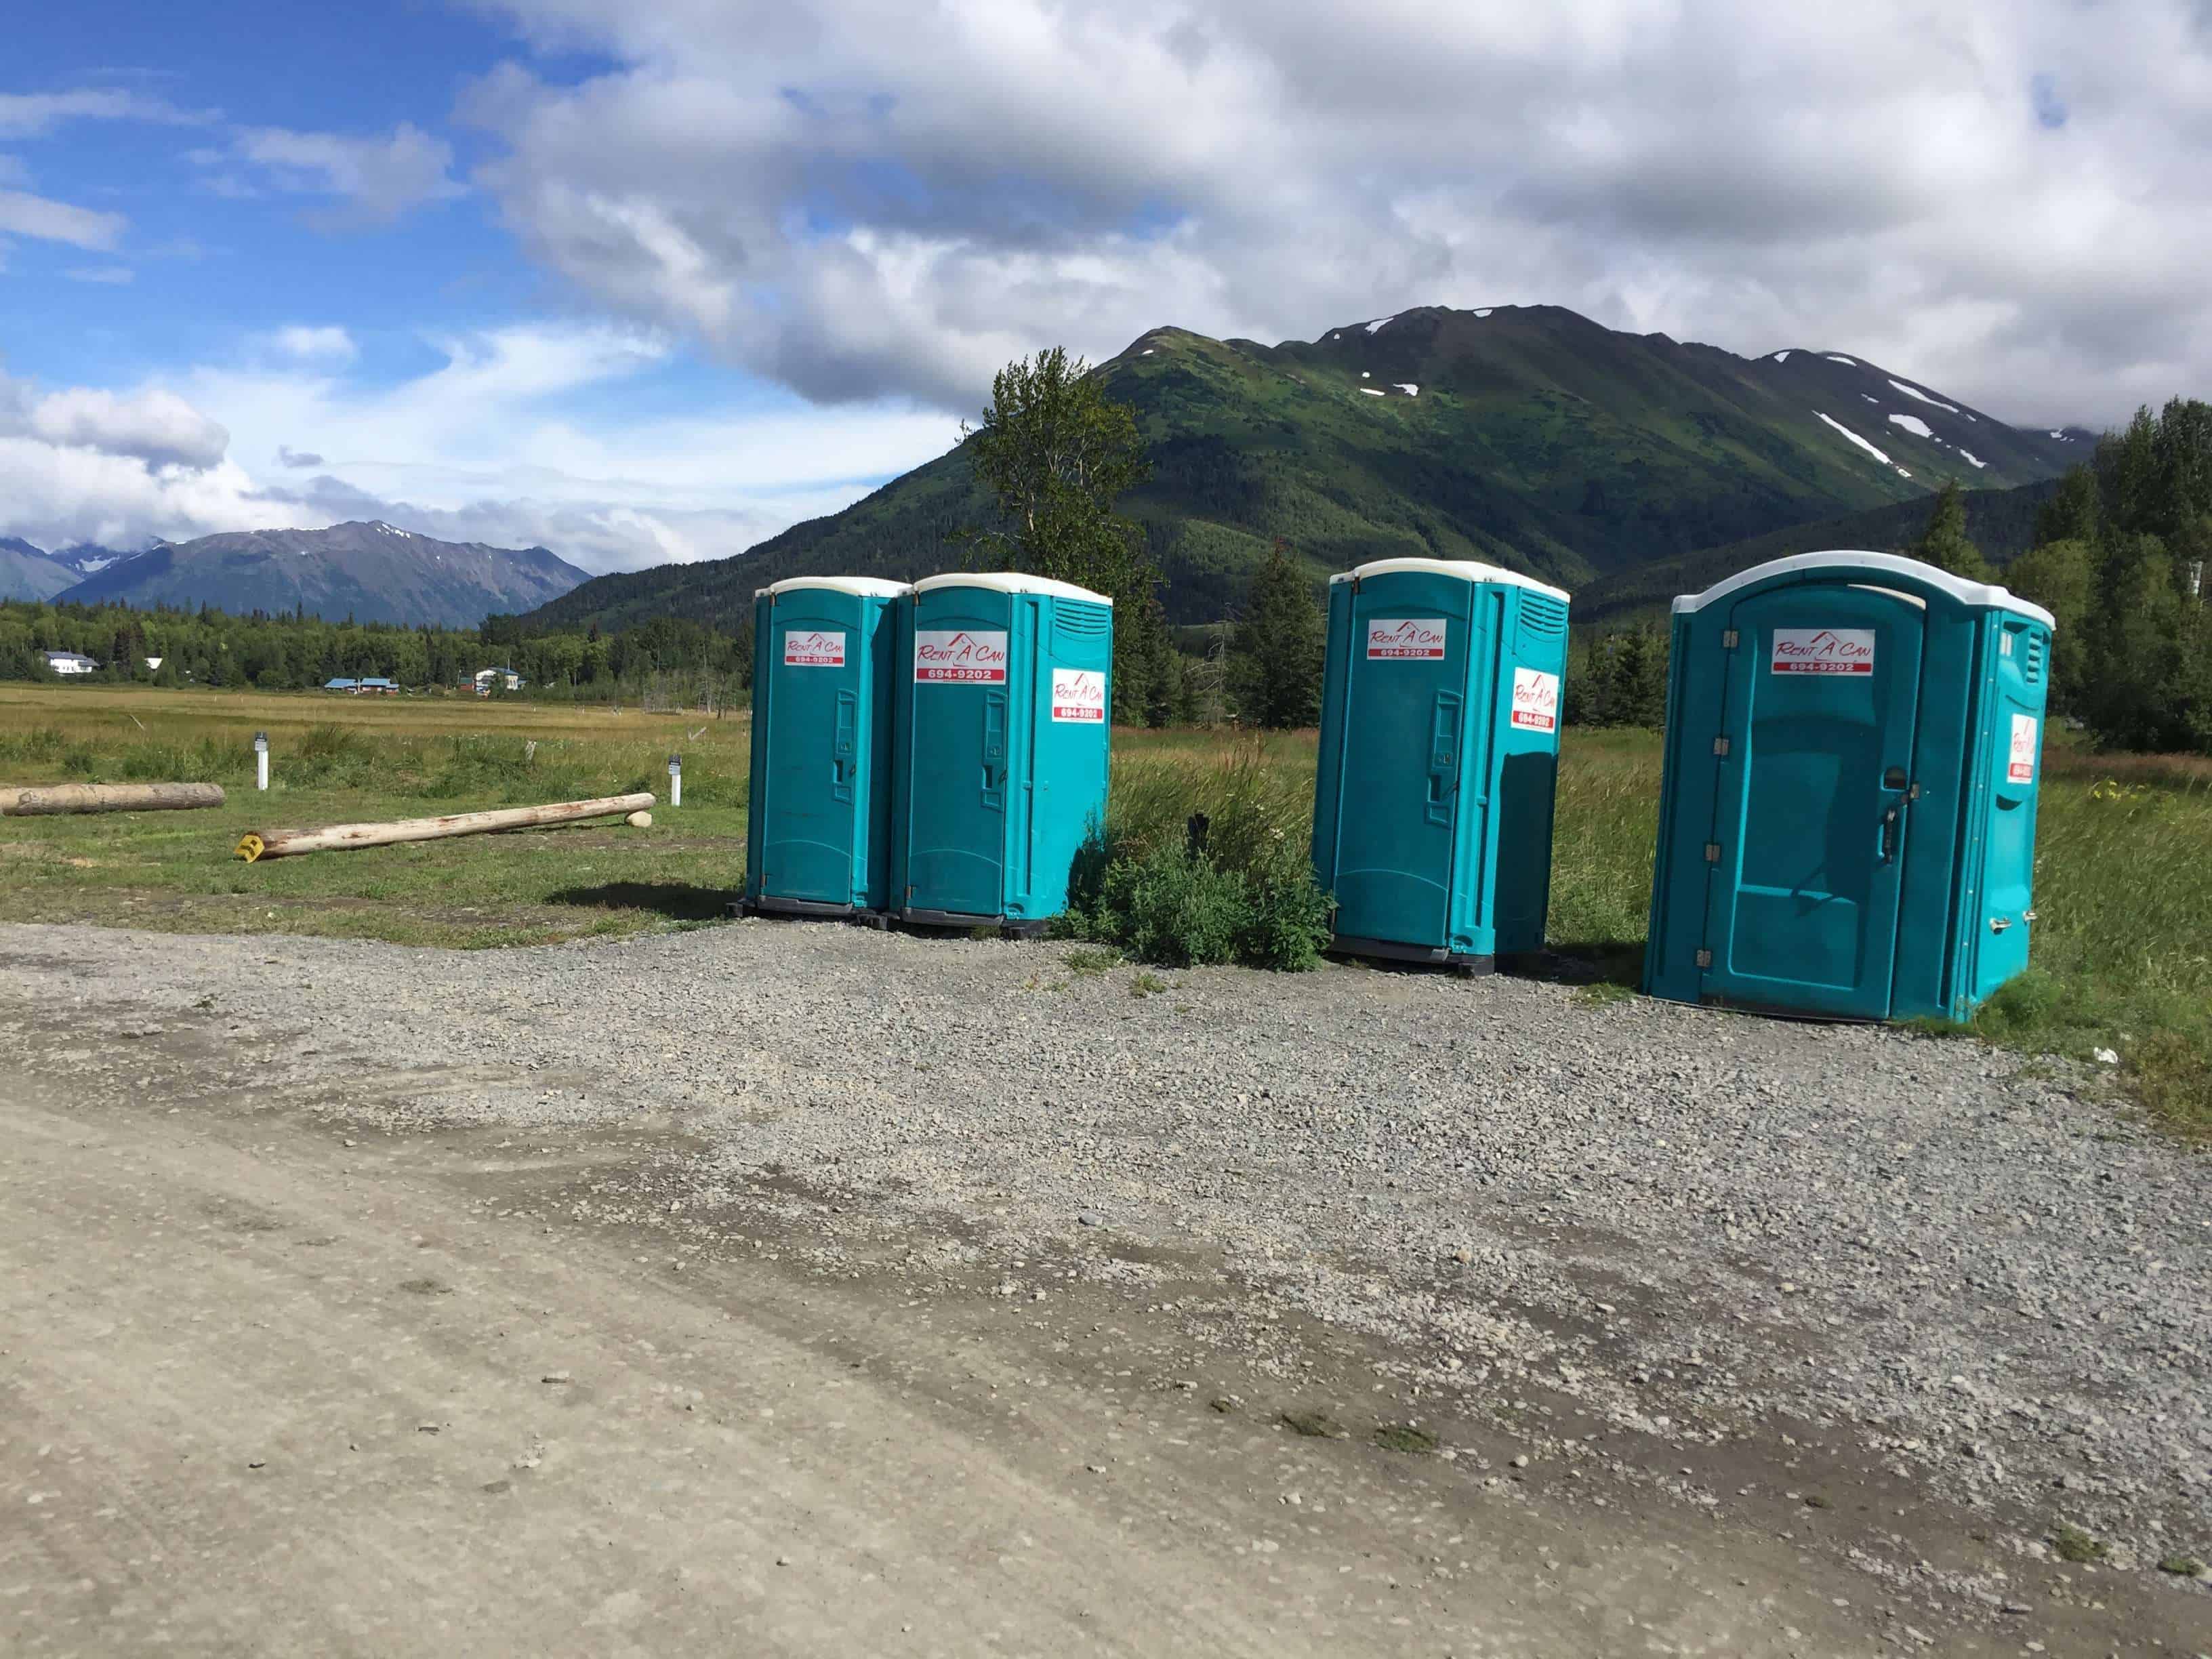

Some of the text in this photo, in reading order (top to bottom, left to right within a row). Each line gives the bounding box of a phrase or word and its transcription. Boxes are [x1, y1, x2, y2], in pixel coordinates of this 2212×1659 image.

[1403, 630, 1416, 642] A
[813, 640, 822, 651] A
[1776, 641, 1871, 657] RENT A CAN
[918, 644, 1004, 662] RENT A CAN
[1789, 663, 1855, 672] 694-9202
[928, 670, 991, 679] 694-9202
